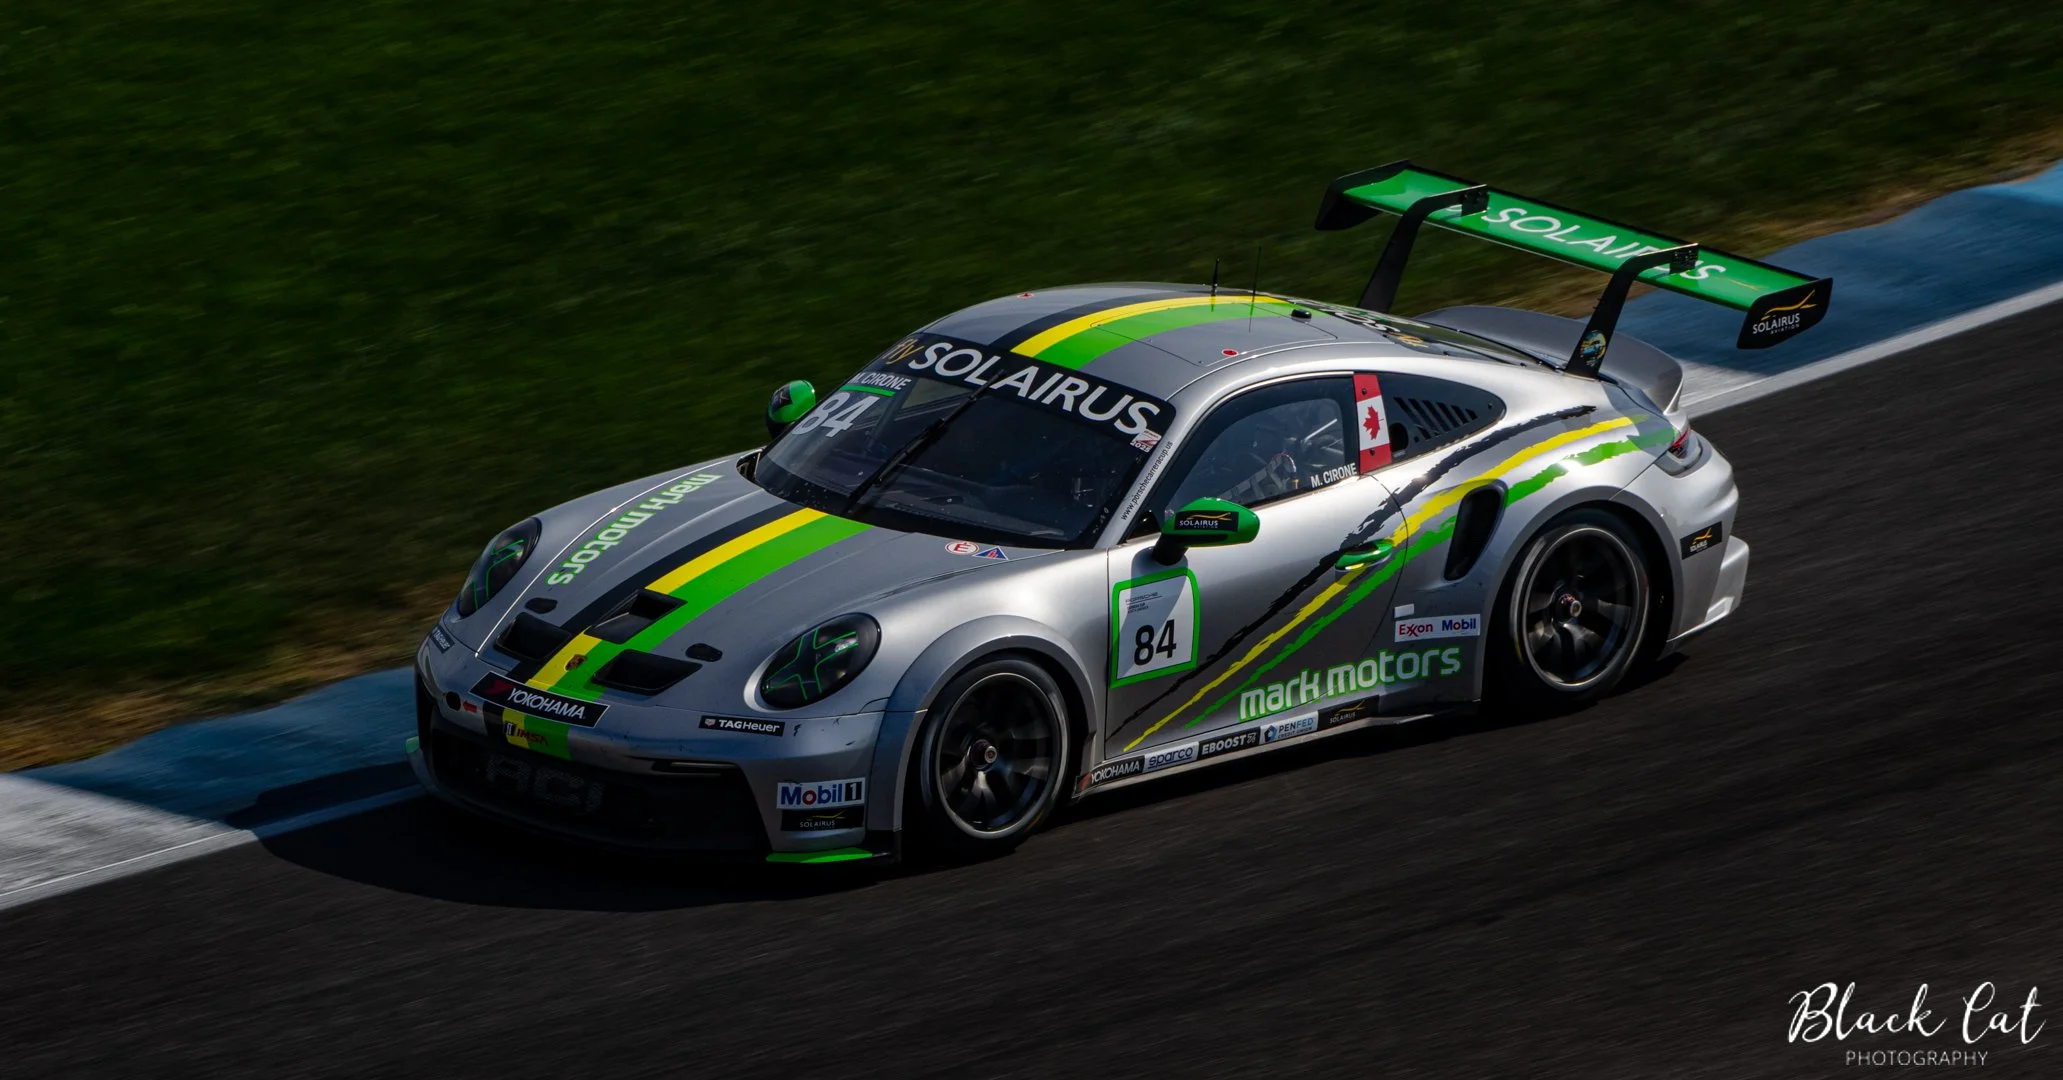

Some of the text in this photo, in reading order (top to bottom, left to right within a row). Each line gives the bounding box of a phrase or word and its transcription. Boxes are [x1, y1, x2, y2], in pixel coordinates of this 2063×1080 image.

[1481, 207, 1726, 280] SOLAIS
[1752, 313, 1800, 335] SOLAIRUS
[862, 372, 912, 390] CIRONE
[908, 342, 1160, 435] SOLAIRUS
[791, 391, 880, 438] 84
[1121, 440, 1174, 521] www.porschecarreracup.us
[1310, 462, 1358, 488] M. CIRONE
[545, 472, 725, 586] mark motors
[1179, 519, 1219, 527] SOLAIRUS
[1399, 617, 1477, 637] Exxon Mobil
[1133, 618, 1177, 666] 84
[1239, 647, 1461, 720] mark motors
[507, 687, 586, 720] YOKOHAMA
[1278, 717, 1314, 733] PENFED
[1148, 747, 1194, 768] sparco
[1201, 735, 1247, 755] EBOOST
[1091, 760, 1140, 785] YOKOHAMA
[780, 783, 843, 806] Mobil
[799, 819, 836, 828] SOLAIRUS
